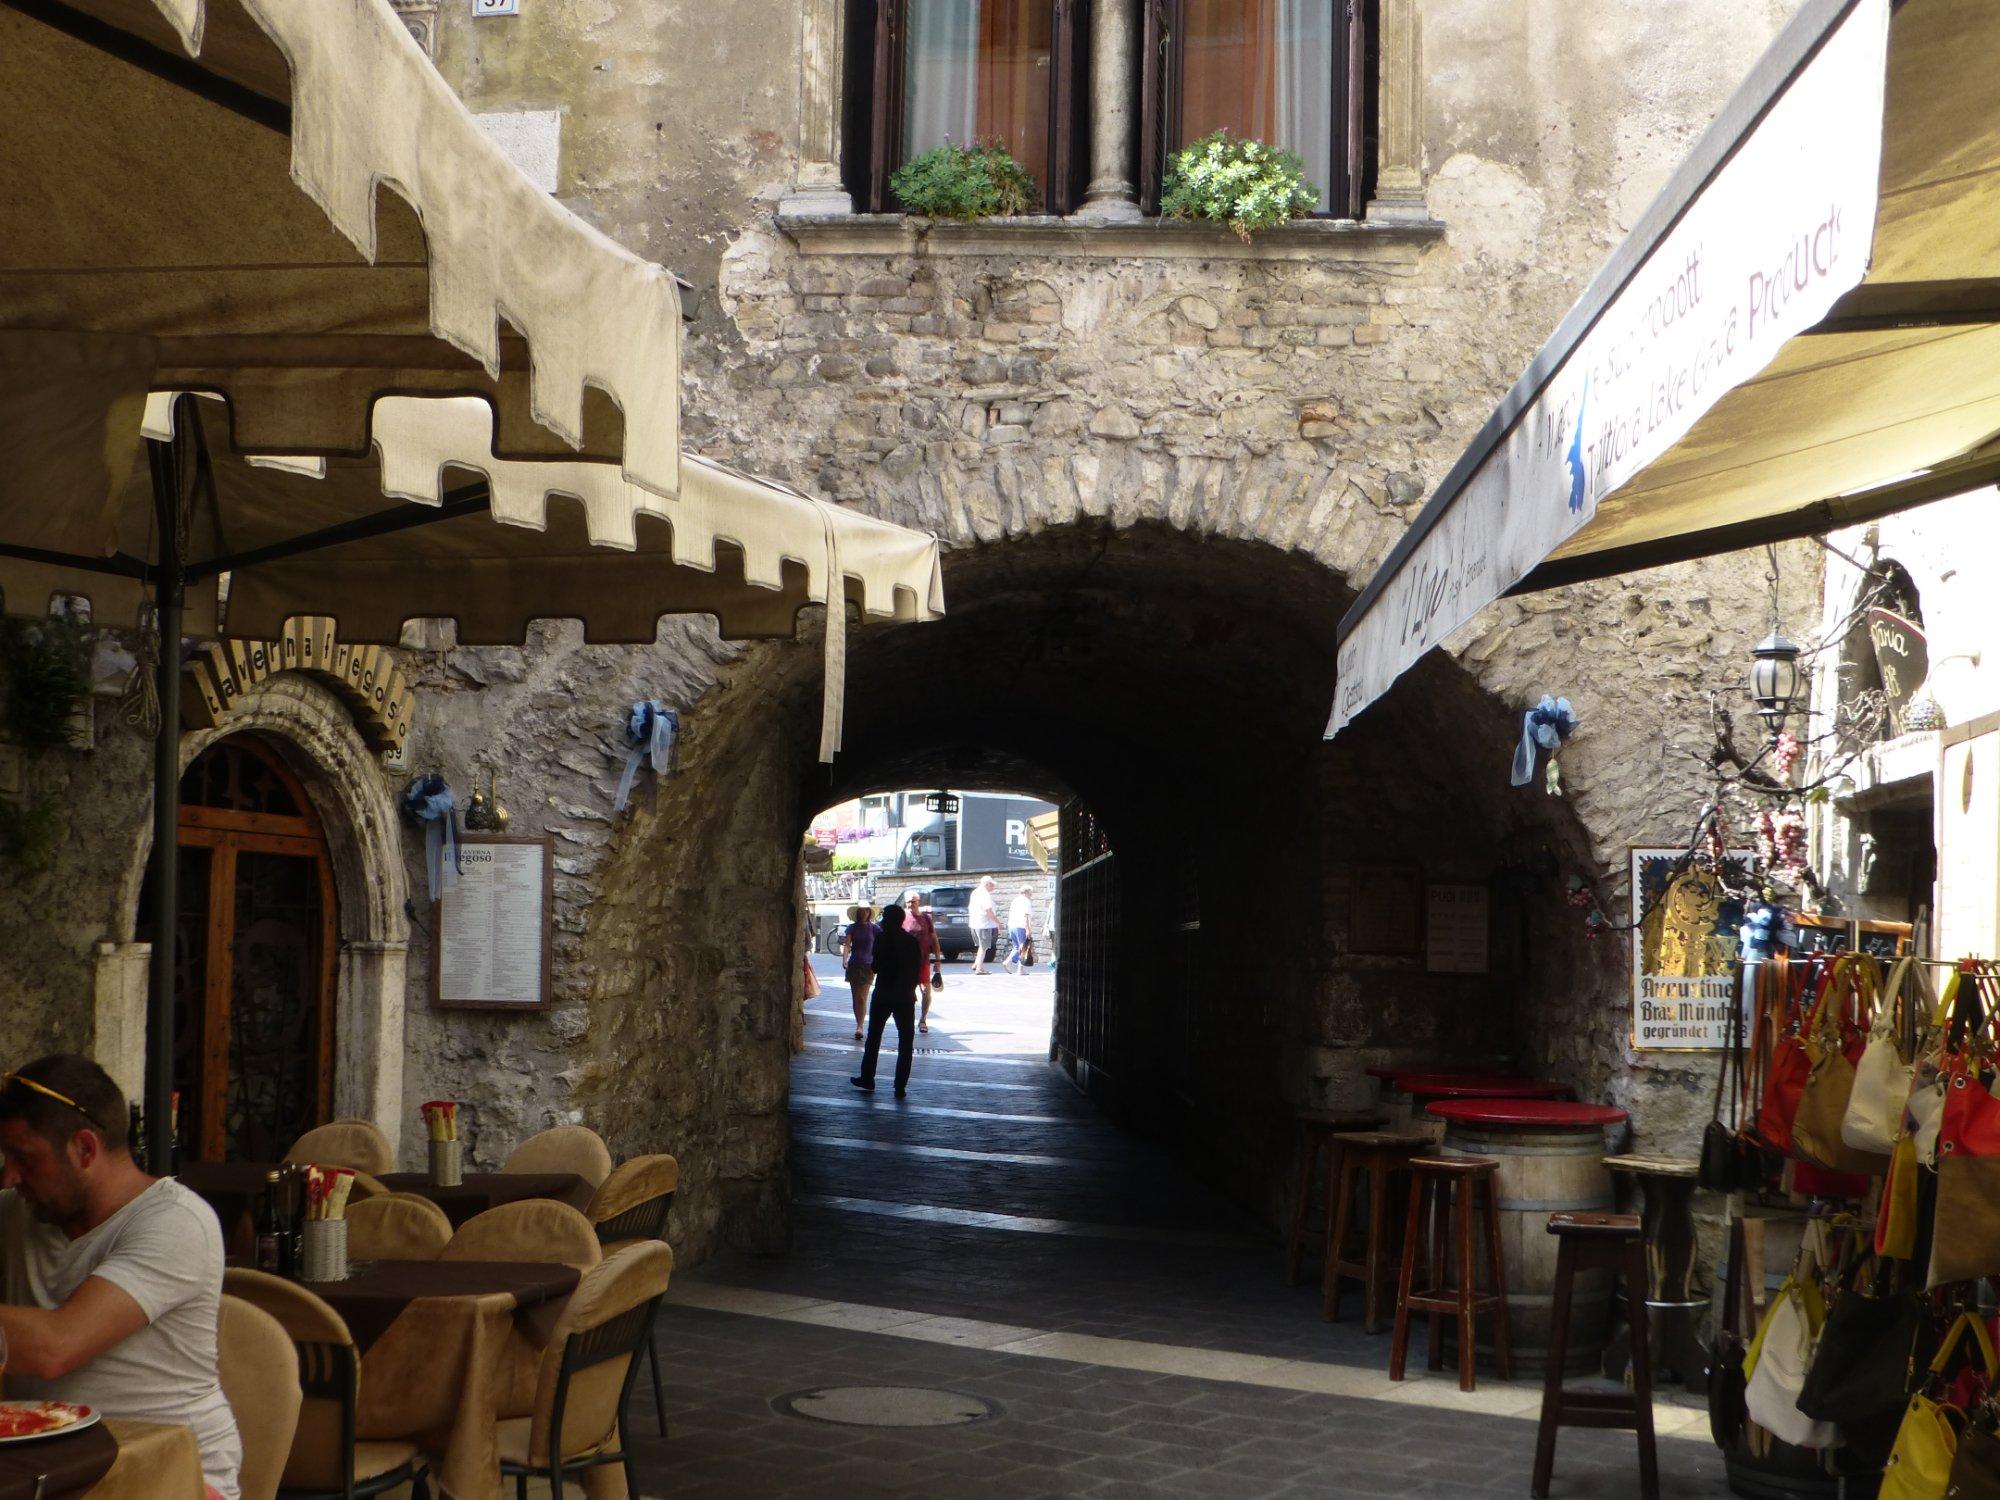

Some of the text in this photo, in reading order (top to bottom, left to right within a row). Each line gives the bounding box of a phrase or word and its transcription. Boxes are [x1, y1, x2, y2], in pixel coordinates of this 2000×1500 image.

[206, 633, 406, 738] taverna fregoso
[1641, 978, 1735, 999] Augustine
[1679, 1002, 1748, 1021] Münch
[1643, 1024, 1709, 1040] gegründet
